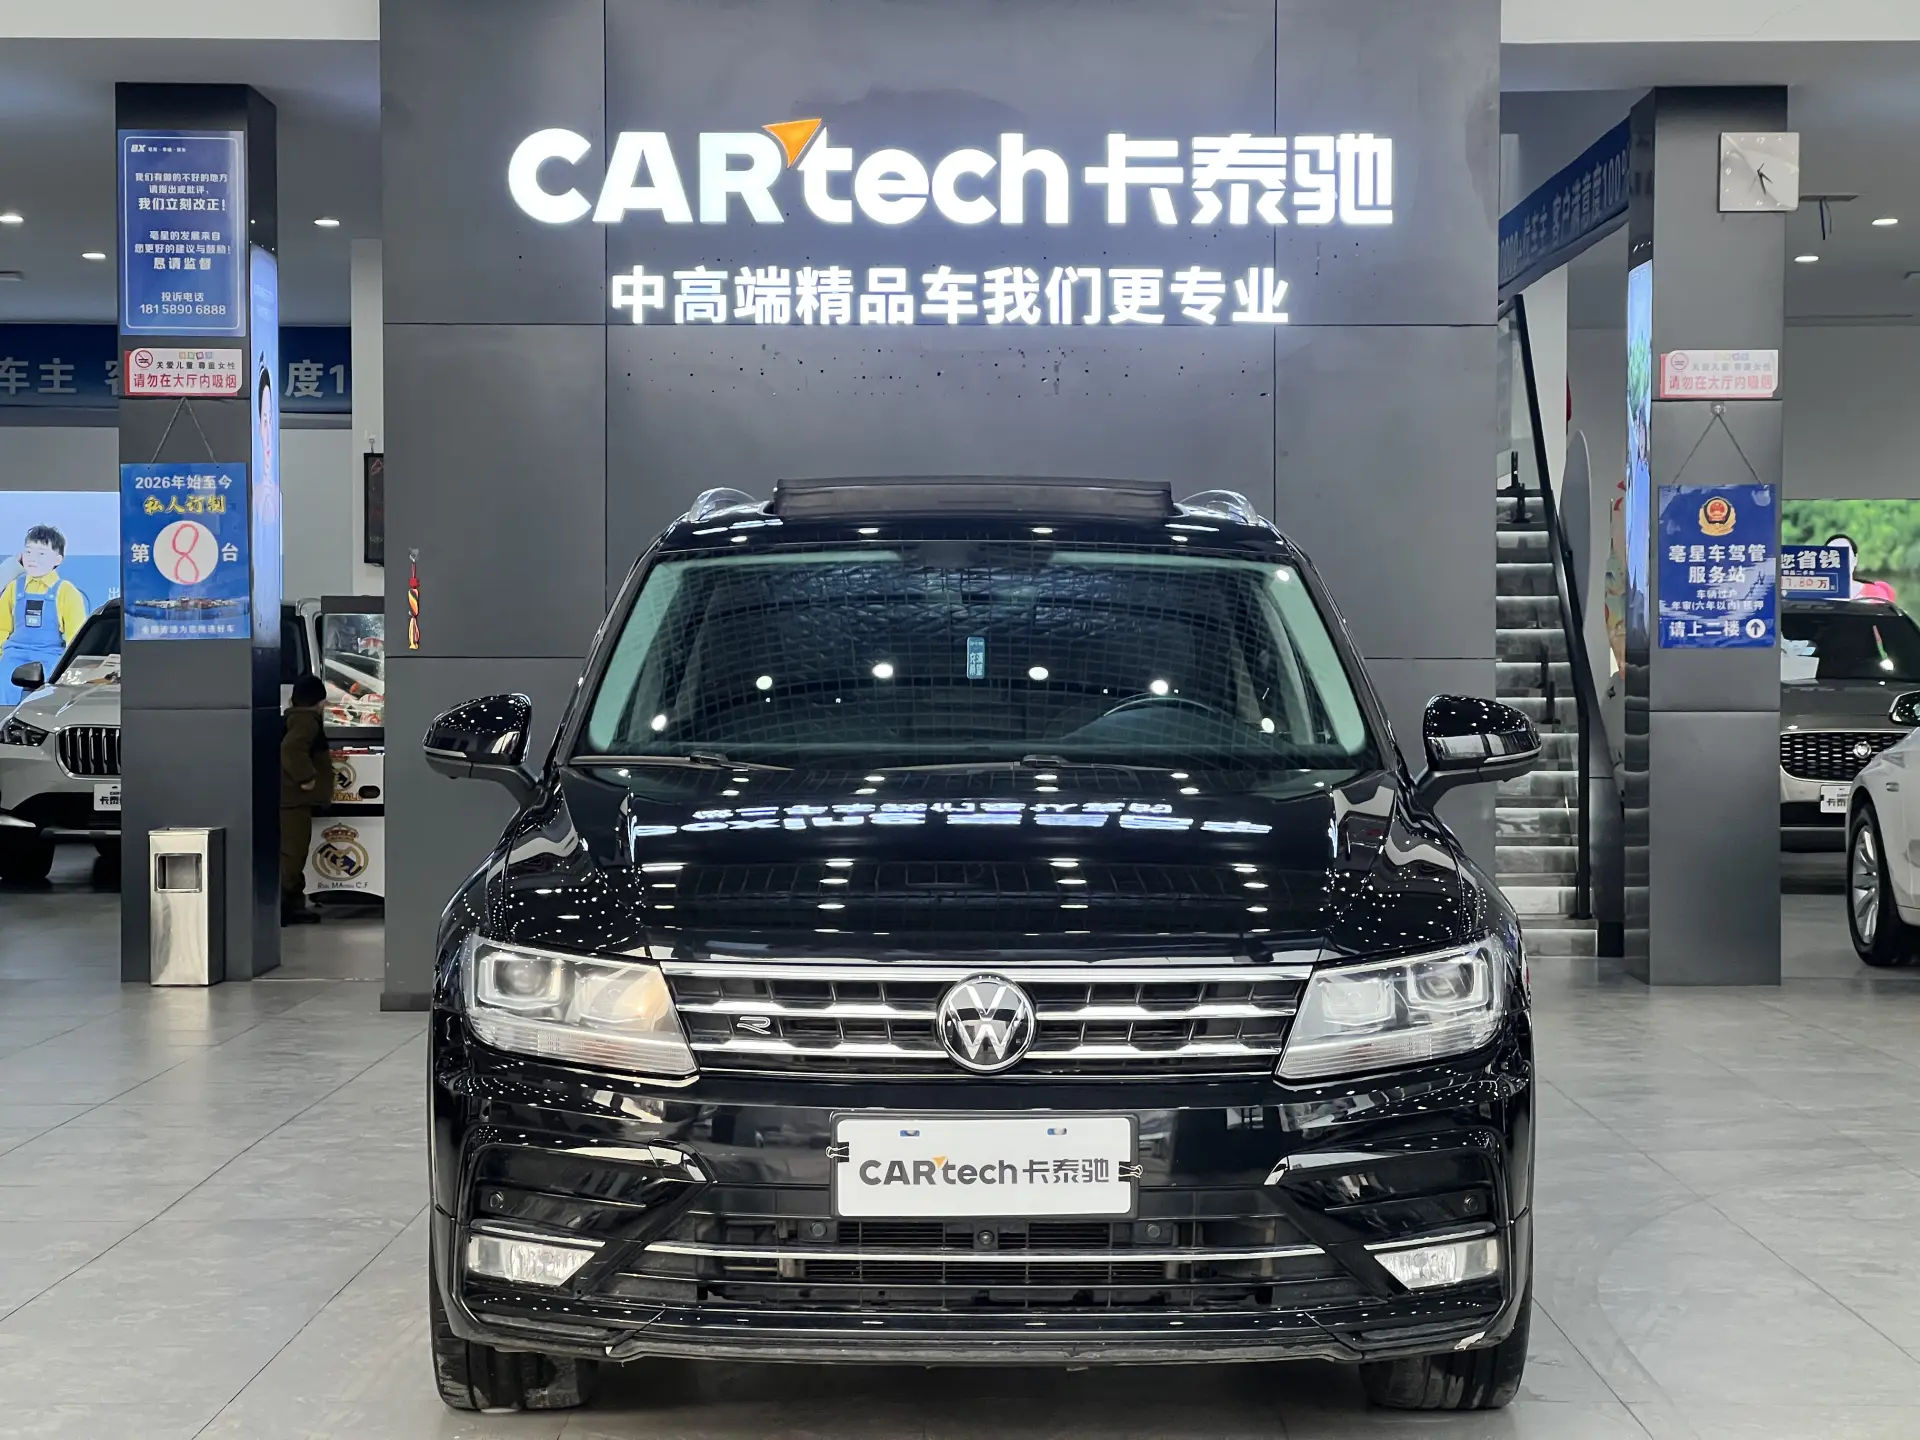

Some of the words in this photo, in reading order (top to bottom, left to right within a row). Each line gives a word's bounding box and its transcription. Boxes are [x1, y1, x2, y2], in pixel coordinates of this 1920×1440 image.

[135, 172, 228, 182] 我们有做的不好的地方
[508, 127, 1069, 224] CARtech
[1084, 133, 1394, 225] 卡泰驰
[153, 257, 212, 270] 恳请监督
[161, 292, 204, 302] 投诉电话
[611, 264, 1290, 325] 中高端精品车我们更专业
[139, 304, 158, 314] 181
[162, 304, 192, 314] 5890
[195, 305, 226, 315] 6888
[156, 362, 193, 370] 关爱儿童
[134, 373, 237, 389] 请勿在大厅内吸烟
[1669, 374, 1773, 390] 请勿在大厅内吸烟
[135, 475, 232, 489] 2026年始至今
[143, 495, 226, 515] 私人订制
[130, 543, 150, 563] 第
[171, 523, 199, 585] 8
[221, 542, 239, 562] 台
[1688, 565, 1746, 584] 服务站
[1669, 621, 1740, 638] 请上二楼
[859, 1159, 1017, 1186] CARtech
[1022, 1158, 1109, 1184] 卡泰驰
